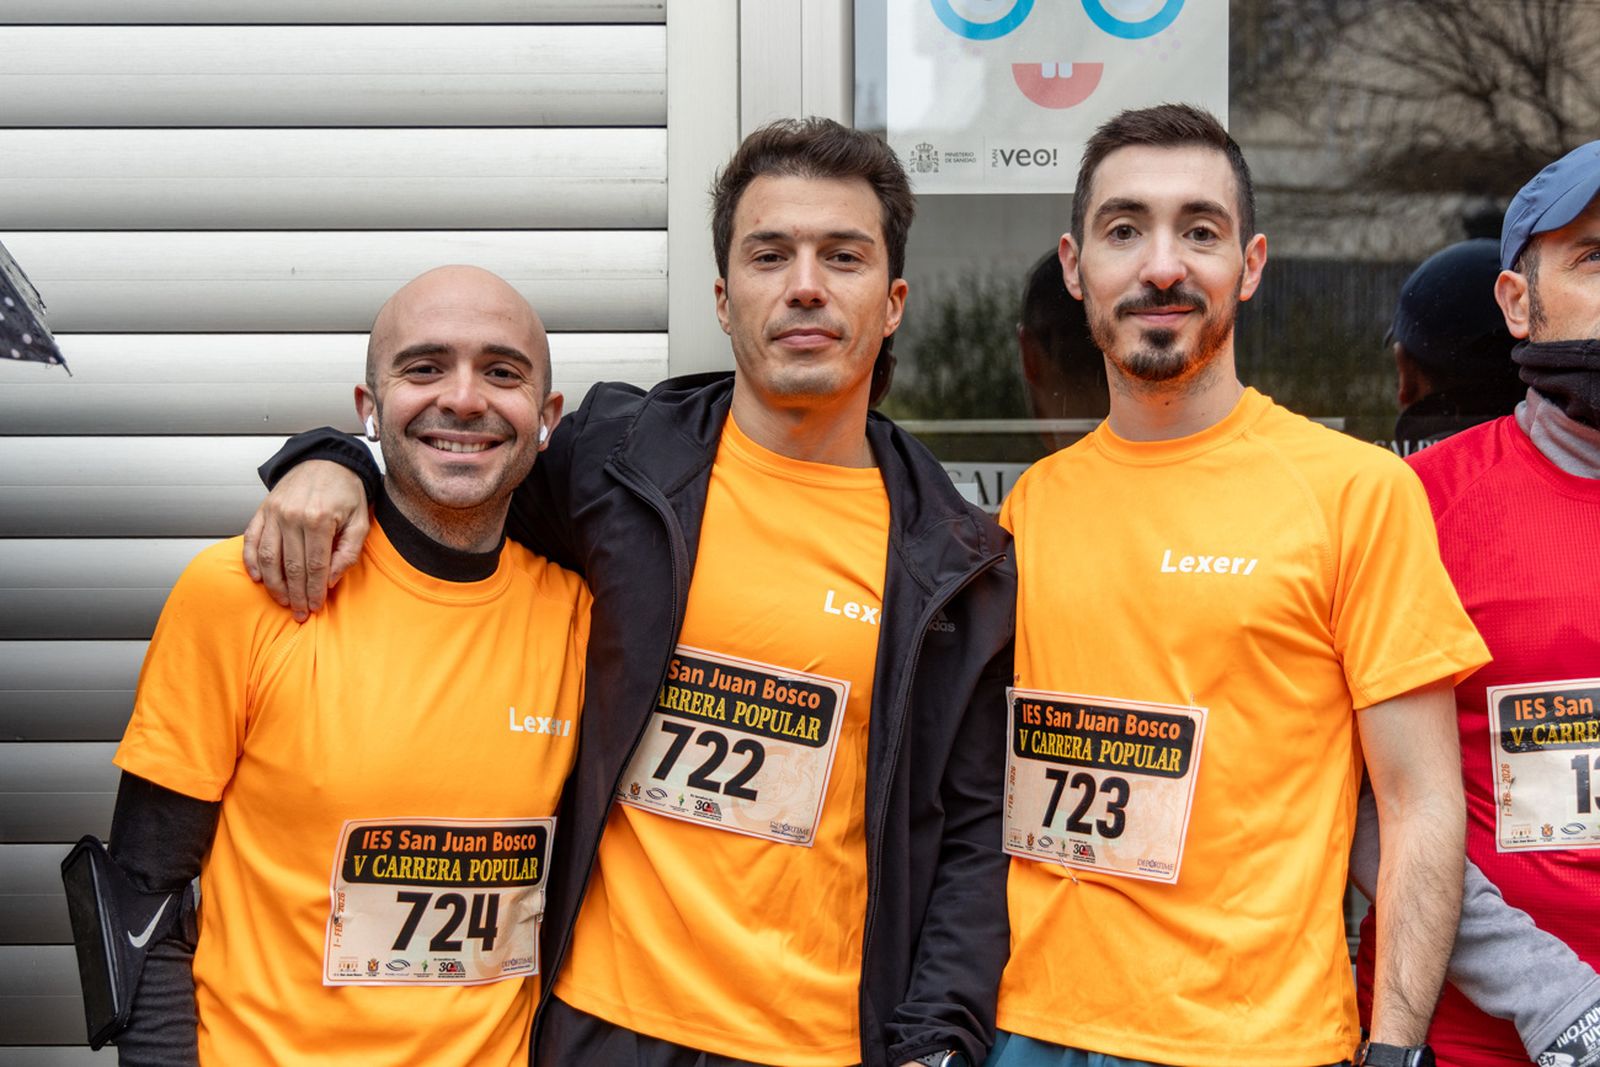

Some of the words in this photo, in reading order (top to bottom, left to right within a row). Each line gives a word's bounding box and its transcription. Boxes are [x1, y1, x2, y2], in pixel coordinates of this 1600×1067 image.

[1000, 148, 1058, 167] veo!
[823, 590, 882, 625] Lex
[668, 660, 704, 685] San
[709, 668, 756, 696] Juan
[762, 678, 820, 709] Bosco
[657, 685, 726, 721] ARRERA
[732, 702, 822, 742] POPULAR
[1022, 704, 1042, 724] IES
[1046, 706, 1072, 728] San
[1076, 709, 1119, 733] Juan
[1125, 714, 1180, 740] Bosco
[1515, 698, 1546, 721] IES
[1554, 696, 1593, 717] San
[1019, 729, 1029, 752] V
[1031, 731, 1092, 761] CARRERA
[1098, 739, 1182, 772] POPULAR
[1510, 726, 1524, 746] V
[652, 720, 766, 802] 722
[1042, 768, 1130, 840] 723
[362, 830, 392, 850] IES
[399, 830, 436, 851] San
[442, 832, 487, 852] Juan
[493, 832, 536, 851] Bosco
[353, 854, 367, 877] V
[372, 854, 462, 881] CARRERA
[468, 857, 538, 882] POPULAR
[391, 890, 501, 952] 724
